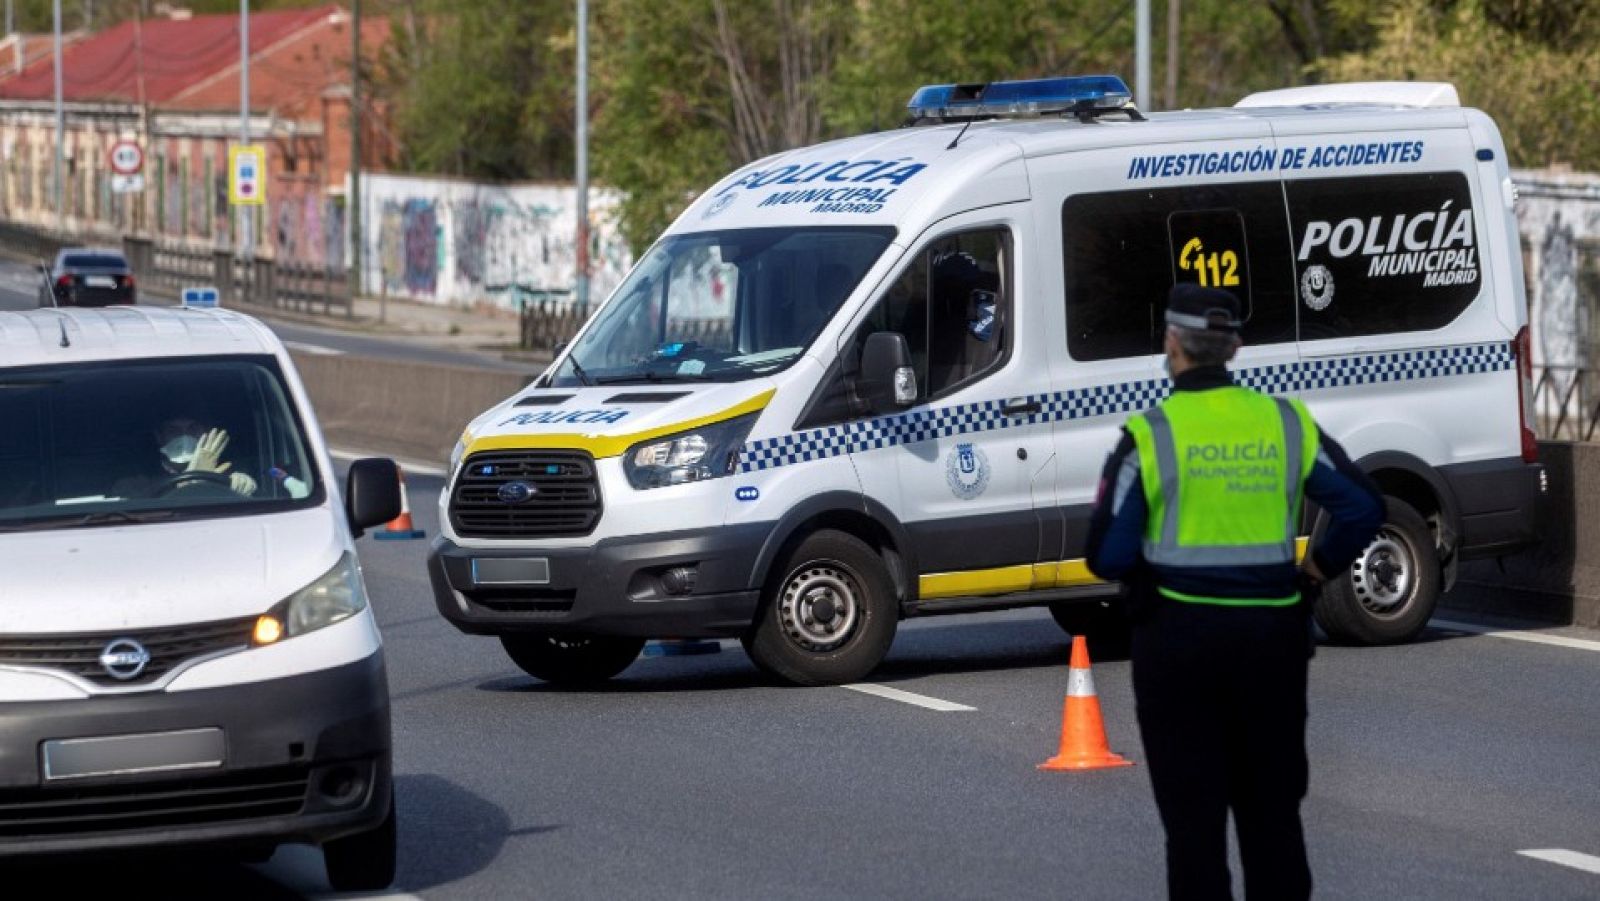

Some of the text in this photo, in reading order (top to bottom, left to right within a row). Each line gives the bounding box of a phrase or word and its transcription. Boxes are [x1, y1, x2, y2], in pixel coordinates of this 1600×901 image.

[1127, 141, 1424, 179] INVESTIGACIÓN DE ACCIDENTES
[714, 157, 928, 198] POLICÍA
[757, 187, 898, 208] MUNICIPAL
[810, 202, 884, 214] MADRID
[1298, 200, 1477, 260] POLICÍA
[1194, 250, 1240, 287] 112
[1367, 248, 1476, 278] MUNICIPAL
[1423, 269, 1478, 288] MADRID
[1187, 439, 1278, 461] POLICÍA
[1187, 465, 1278, 480] MUNICIPAL
